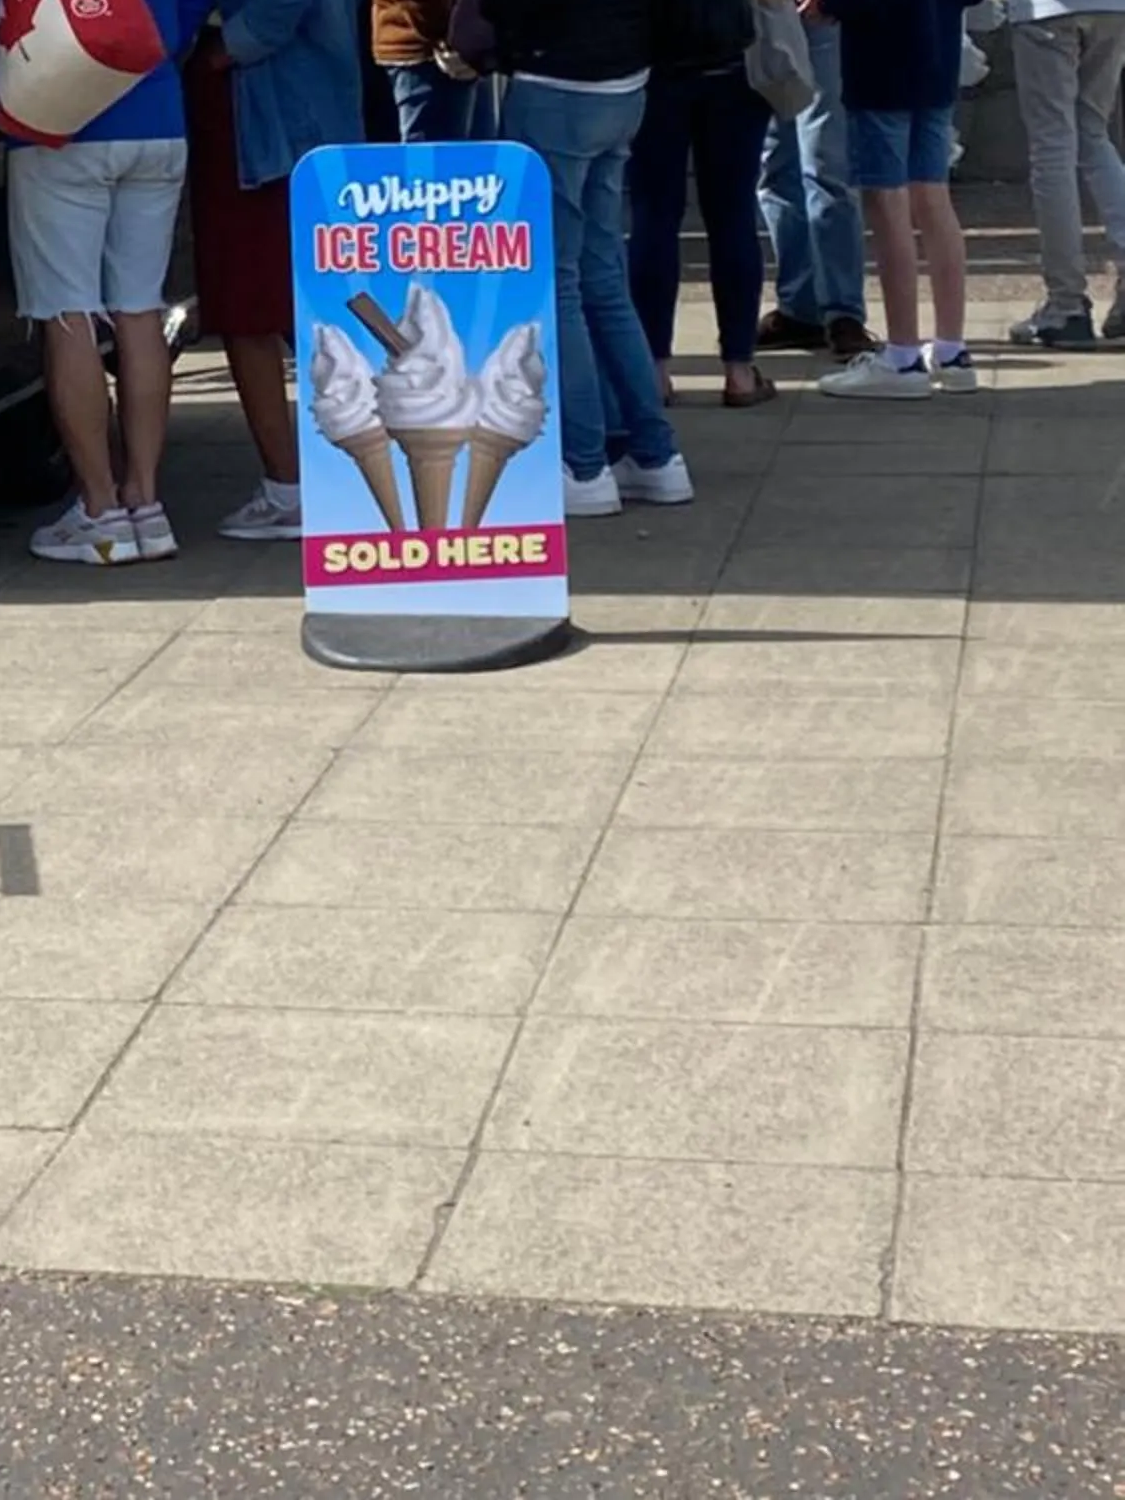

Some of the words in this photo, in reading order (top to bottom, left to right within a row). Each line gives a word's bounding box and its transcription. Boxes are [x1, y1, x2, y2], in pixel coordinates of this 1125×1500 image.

[338, 173, 505, 221] Whippy
[314, 222, 380, 273] ICE
[389, 221, 532, 272] CREAM
[322, 537, 429, 574] SOLD
[437, 532, 549, 567] HERE
